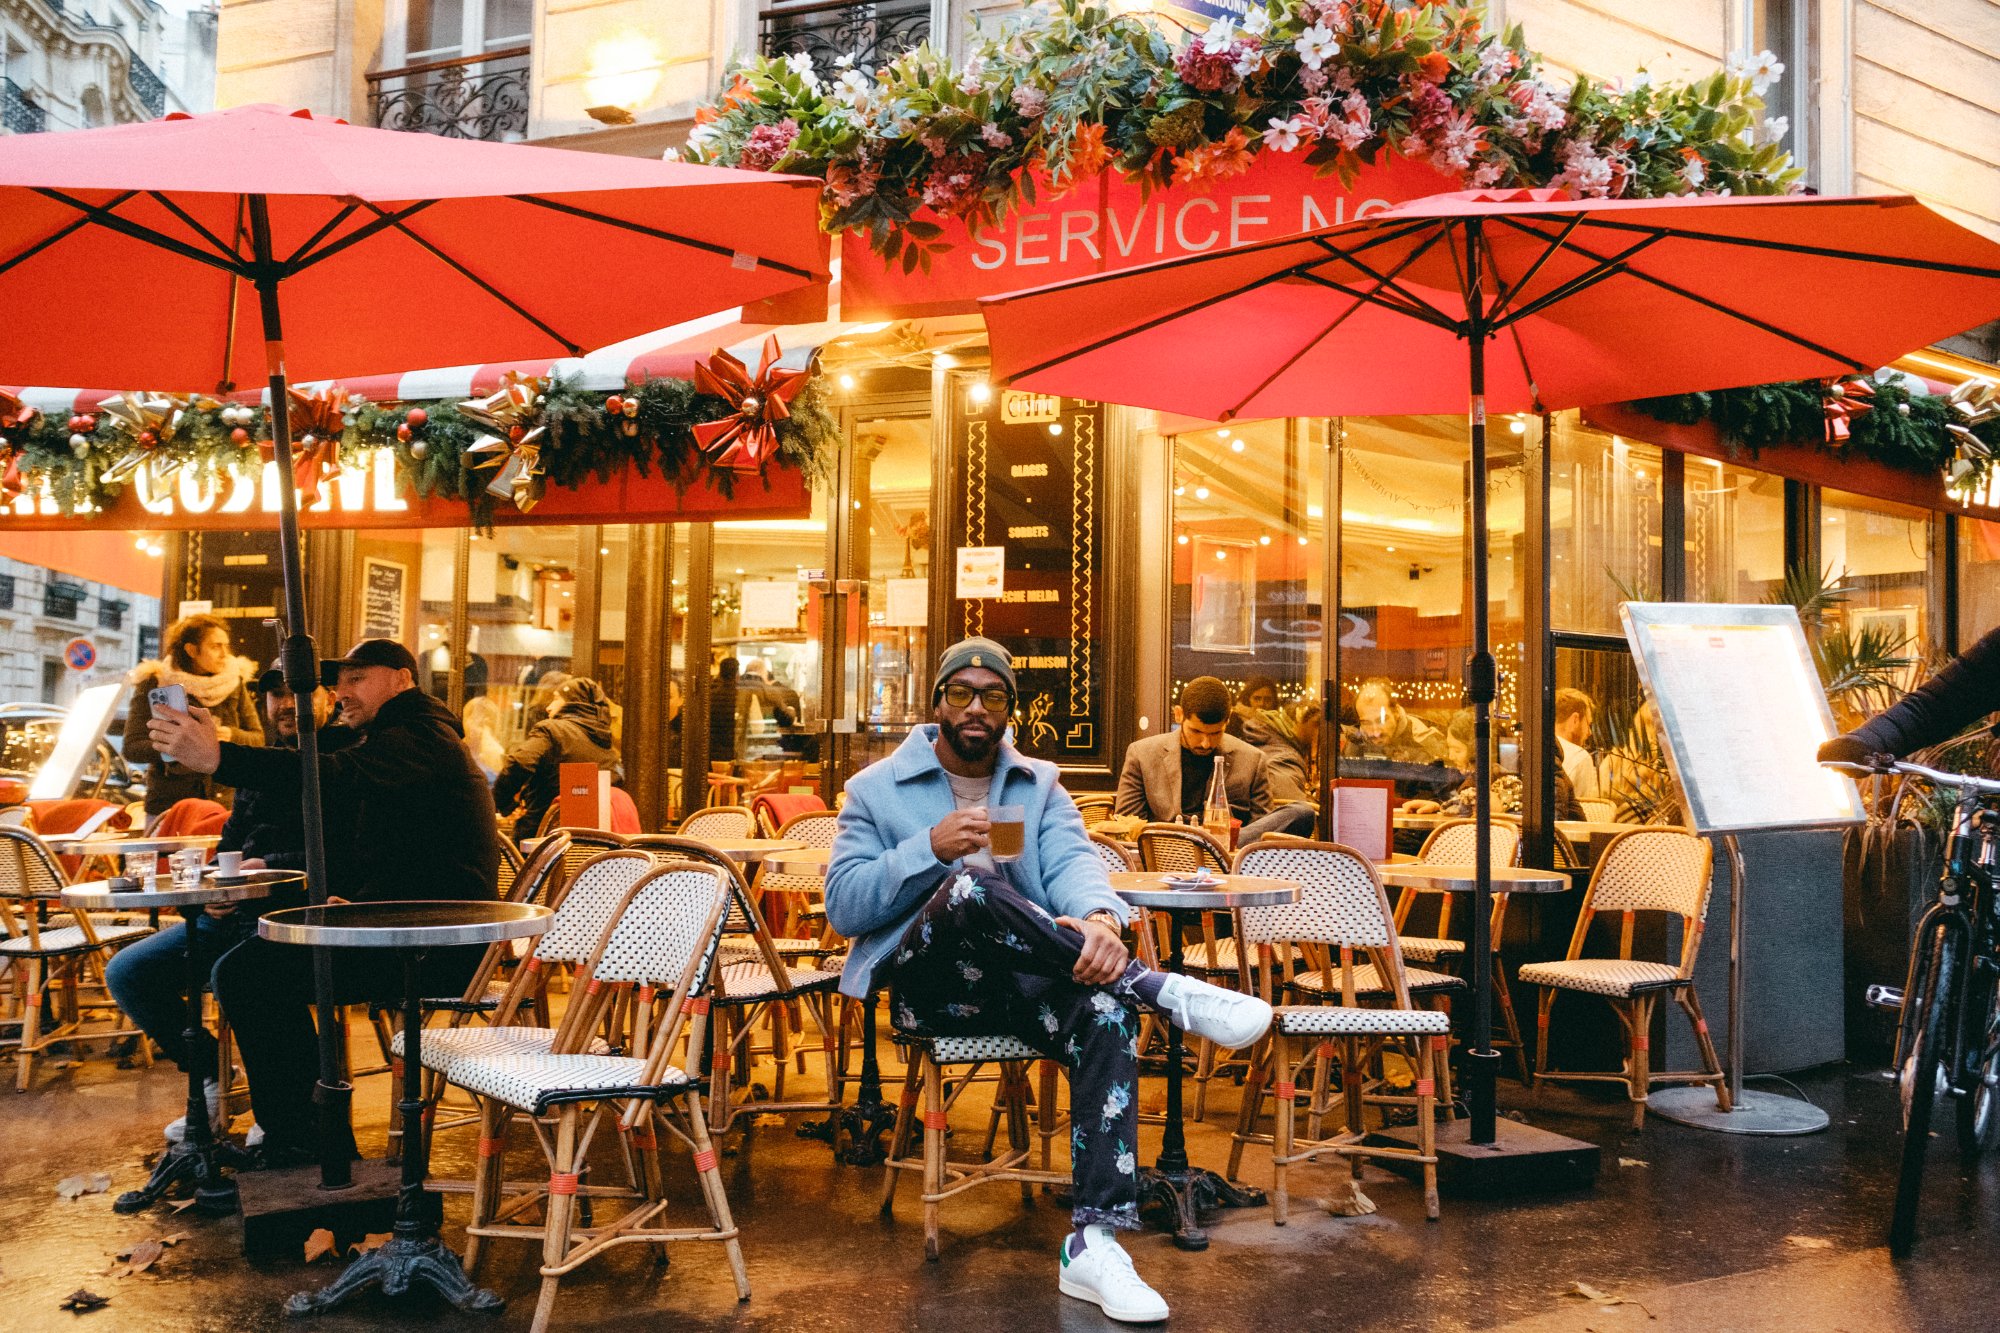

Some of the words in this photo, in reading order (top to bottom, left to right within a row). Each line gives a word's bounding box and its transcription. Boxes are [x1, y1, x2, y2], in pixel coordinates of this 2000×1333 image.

[971, 194, 1272, 271] SERVICE
[1008, 525, 1049, 539] SORBETS
[1026, 589, 1060, 603] MELBA
[1029, 656, 1068, 669] MAISON
